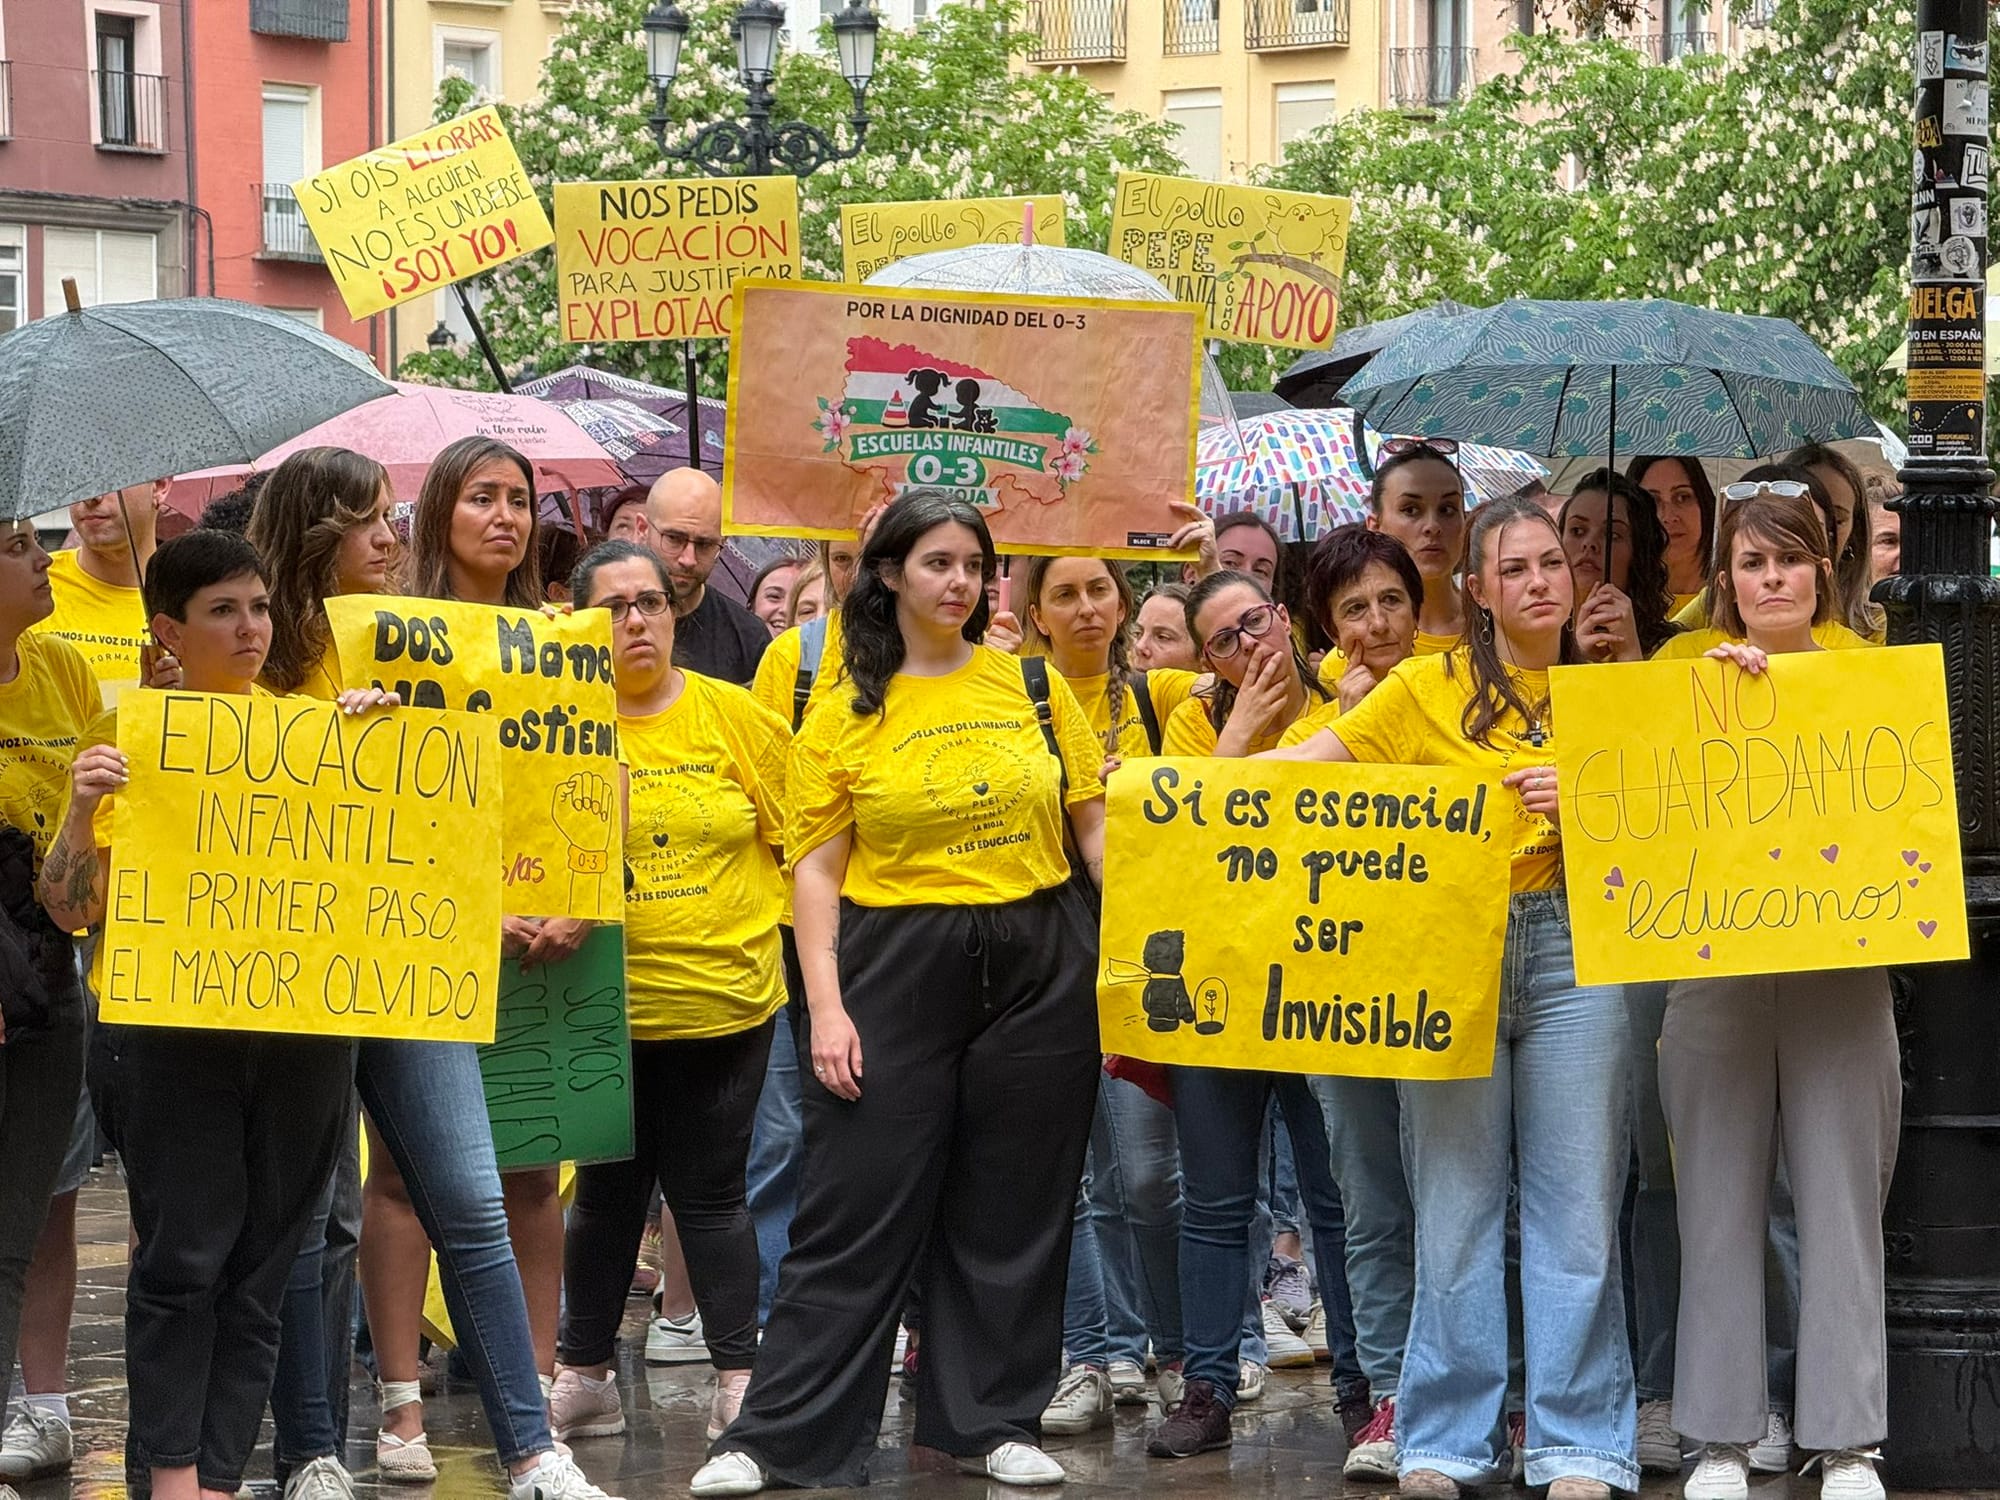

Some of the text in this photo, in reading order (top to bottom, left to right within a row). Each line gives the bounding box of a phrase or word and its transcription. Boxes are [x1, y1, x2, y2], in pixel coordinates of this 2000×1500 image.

[402, 113, 503, 172] LLORAR
[329, 164, 533, 281] NO ES UN BEBÉ
[378, 199, 395, 220] A
[600, 180, 759, 221] NOS PEDÍS
[1121, 178, 1244, 231] El pollo
[850, 212, 956, 257] El pollo
[1121, 228, 1216, 273] PEPE
[378, 218, 522, 300] ¡SOY YO!
[568, 270, 638, 296] PARA
[1220, 280, 1235, 331] COMO
[847, 301, 1086, 330] POR LA DIGNIDAD DEL 0-3
[1232, 276, 1334, 344] APOYO
[1922, 330, 1936, 340] EN
[1940, 328, 1982, 340] ESPAÑA
[476, 424, 548, 435] in the rain
[857, 434, 1038, 464] ESCUELAS INFANTILES
[915, 455, 978, 485] 0-3
[85, 634, 96, 643] LA
[98, 635, 118, 646] VOZ
[120, 638, 133, 646] DE
[374, 610, 616, 690] DOS Mano
[1691, 664, 1777, 734] NO
[160, 695, 480, 808] EDUCACIÓN
[892, 720, 1022, 753] SOMOS LA VOZ DE LA INFANCIA
[631, 768, 650, 779] VOZ
[664, 767, 676, 775] LA
[677, 763, 716, 774] INFANCIA
[924, 737, 1024, 782] PLATAFORMA LABORAL
[1574, 721, 1944, 843] GUARDAMOS
[668, 782, 710, 814] LABORAL
[926, 768, 1032, 821] ESCUELAS INFANTILES
[972, 796, 1000, 809] PLEI
[1143, 766, 1492, 844] Si es esencial,
[661, 822, 712, 872] INFANTILES
[947, 832, 1031, 856] 0-3 ES EDUCACIÓN
[972, 820, 1004, 832] LA RIOJA
[650, 850, 677, 860] PLEI
[1524, 846, 1535, 854] ES
[626, 884, 708, 903] 0-3 ES EDUCACIÓN
[652, 872, 682, 883] LA RIOJA
[1217, 842, 1430, 905] no puede
[115, 869, 458, 944] EL PRIMER PASO,
[1293, 914, 1364, 956] ser
[110, 948, 480, 1020] EL MAYOR OLVIDO
[1262, 962, 1452, 1053] Invisible
[562, 986, 624, 1093] SOMOS
